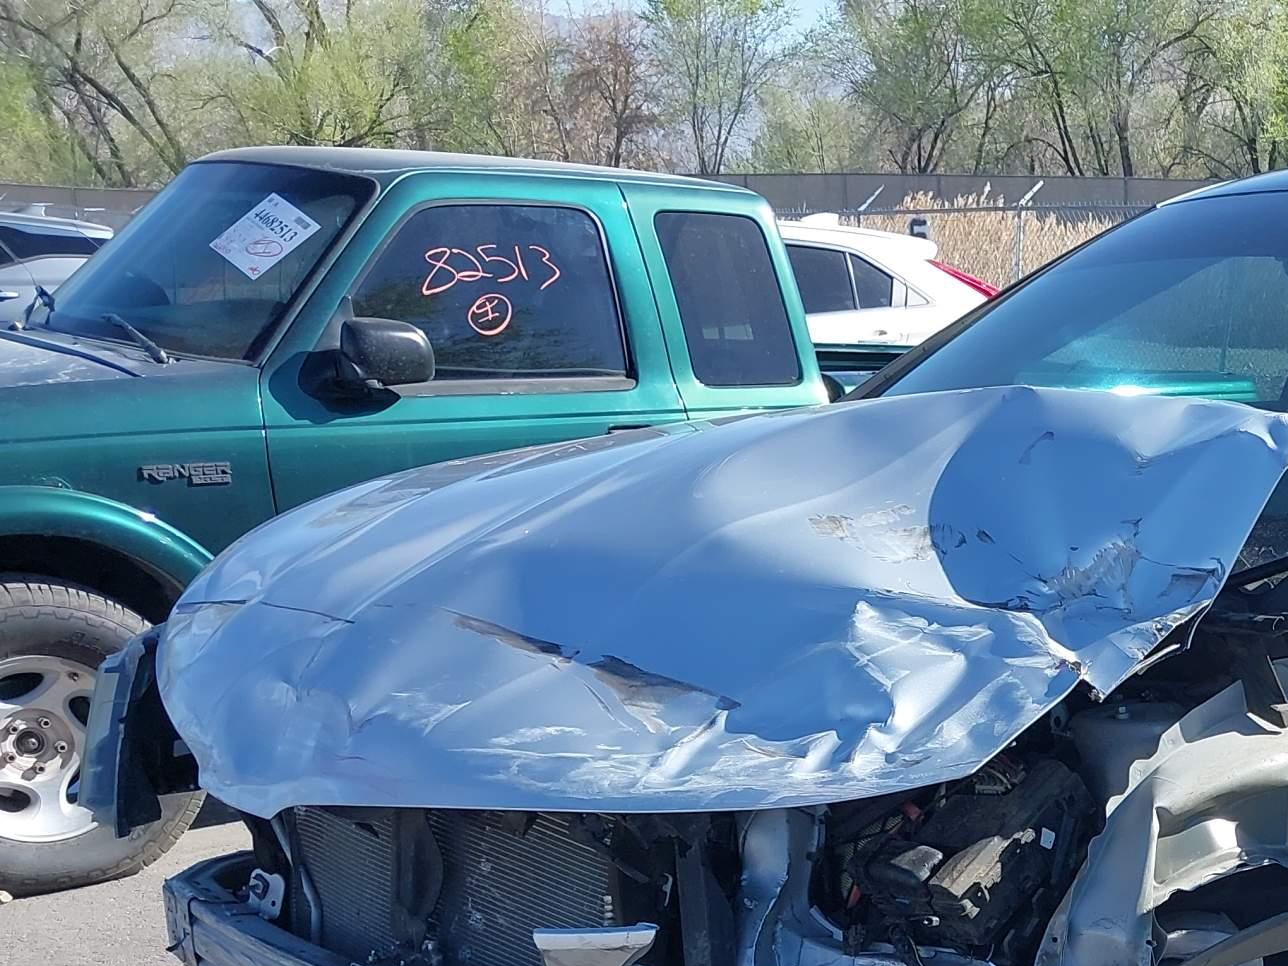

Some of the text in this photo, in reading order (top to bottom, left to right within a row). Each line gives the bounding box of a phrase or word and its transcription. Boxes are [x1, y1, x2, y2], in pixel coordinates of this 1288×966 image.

[254, 209, 298, 242] 44682513
[422, 244, 560, 295] 82513
[142, 463, 232, 480] RANGER
